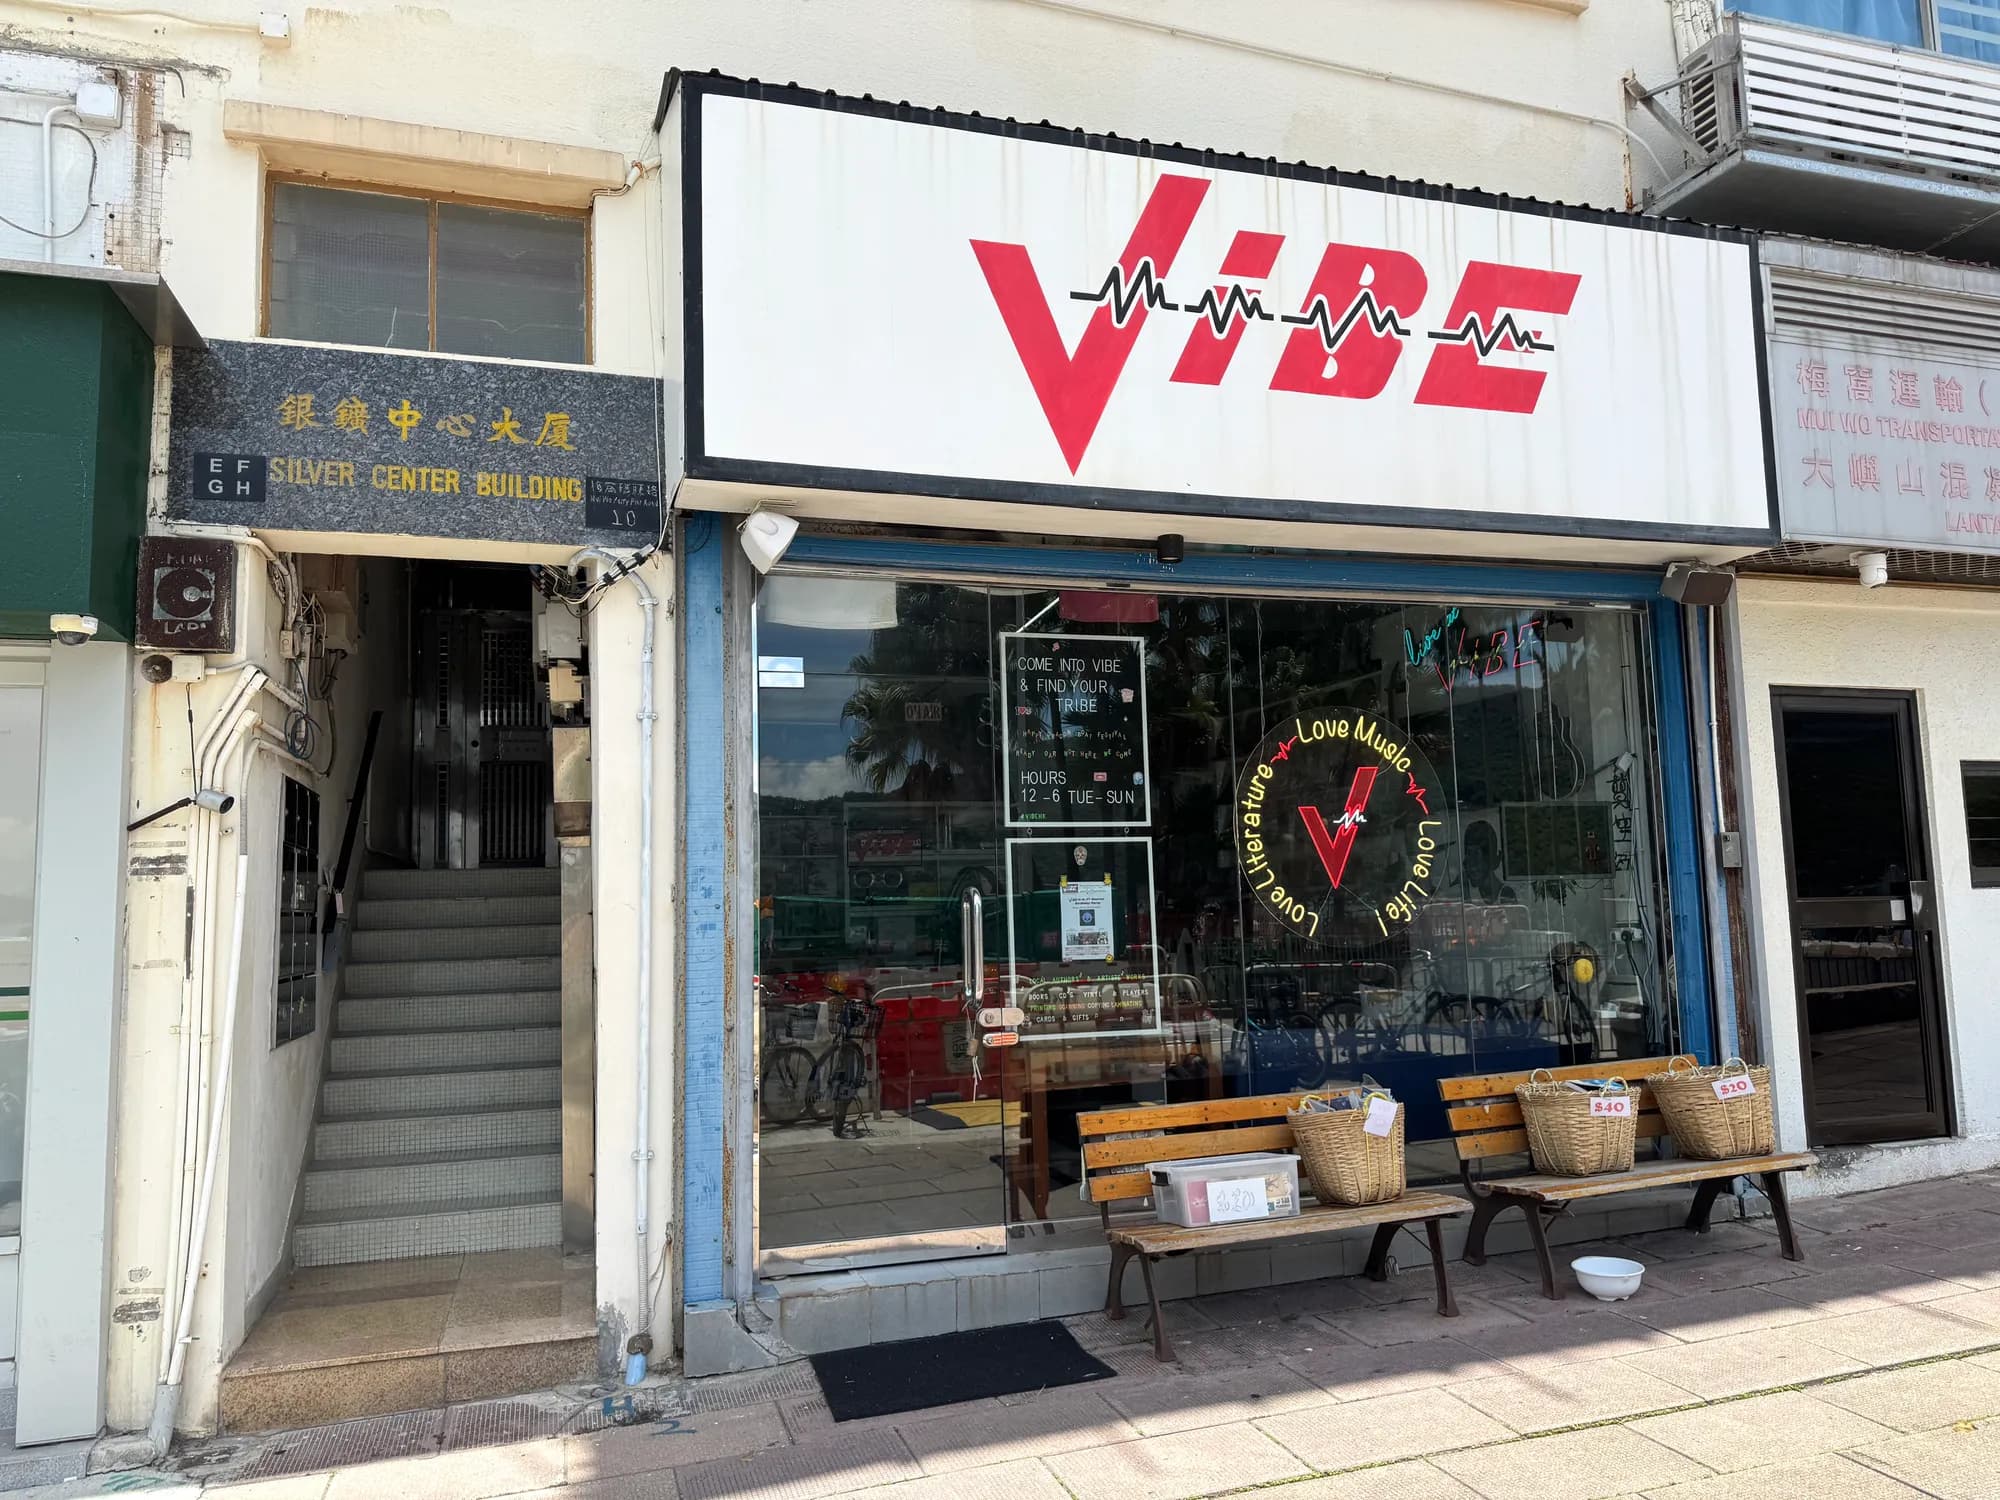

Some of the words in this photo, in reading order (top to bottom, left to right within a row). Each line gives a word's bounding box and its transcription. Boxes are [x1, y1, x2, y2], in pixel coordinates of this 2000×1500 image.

[1797, 408, 1835, 432] MUI
[1840, 412, 1873, 435] WO
[210, 458, 223, 474] E
[237, 459, 250, 475] F
[208, 478, 224, 494] G
[236, 480, 251, 495] H
[270, 456, 355, 487] SILVER
[372, 463, 460, 494] CENTER
[476, 470, 583, 502] BUILDING
[612, 509, 636, 527] 10
[1017, 656, 1053, 672] COME
[1060, 658, 1086, 673] INTO
[1092, 659, 1121, 673] VIBE
[1020, 678, 1029, 693] &
[1037, 679, 1067, 693] FIND
[1070, 679, 1108, 694] YOUR
[1056, 698, 1098, 713] TRIBE
[1296, 718, 1350, 744] Love
[1354, 714, 1412, 773] Music
[1021, 770, 1067, 785] HOURS
[1241, 762, 1276, 892] Literature
[1412, 820, 1443, 879] Love
[1269, 886, 1320, 938] Love
[1028, 992, 1049, 1001] BOOKS
[1122, 988, 1149, 998] PLAYERS
[1720, 1080, 1748, 1096] $20
[1594, 1101, 1625, 1114] $40
